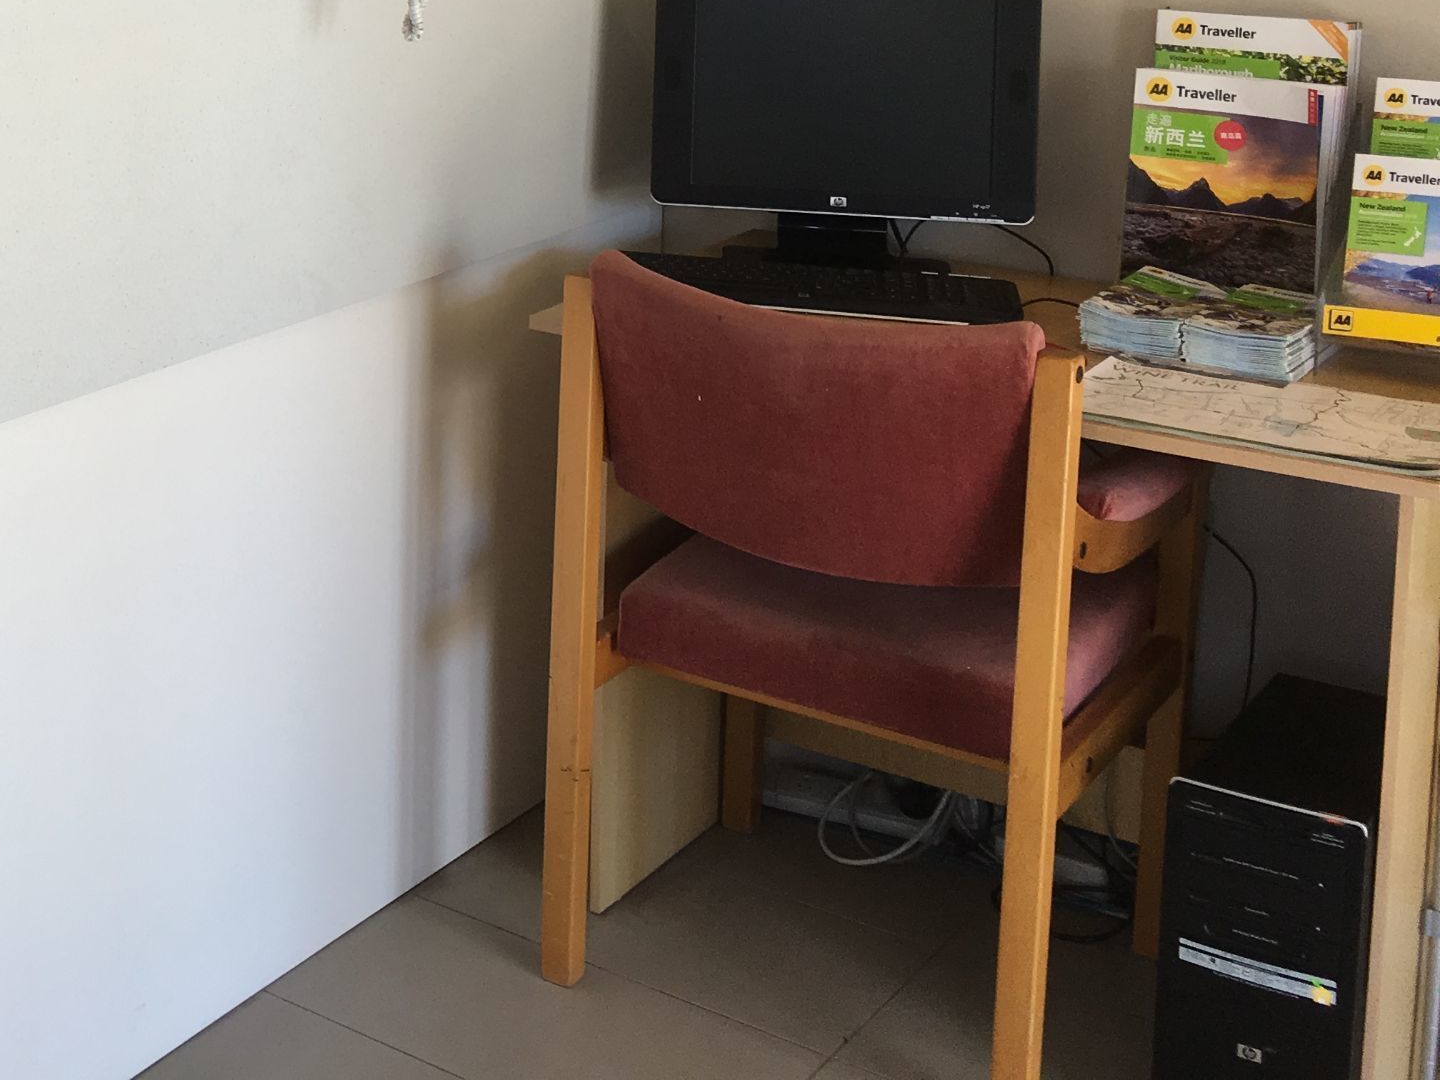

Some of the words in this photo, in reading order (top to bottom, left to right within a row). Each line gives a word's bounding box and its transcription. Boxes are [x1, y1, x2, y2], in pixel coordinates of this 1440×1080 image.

[1175, 23, 1193, 34] AA
[1200, 24, 1257, 40] Traveller
[1149, 83, 1169, 96] AA
[1176, 85, 1237, 103] Traveller
[1387, 93, 1404, 103] AA
[1398, 125, 1428, 134] Zealand
[1144, 125, 1206, 149] 新西兰
[1366, 170, 1382, 181] AA
[1389, 172, 1440, 187] Traveller
[1359, 202, 1376, 210] New
[1377, 203, 1407, 212] Zealand
[1333, 314, 1352, 326] AA
